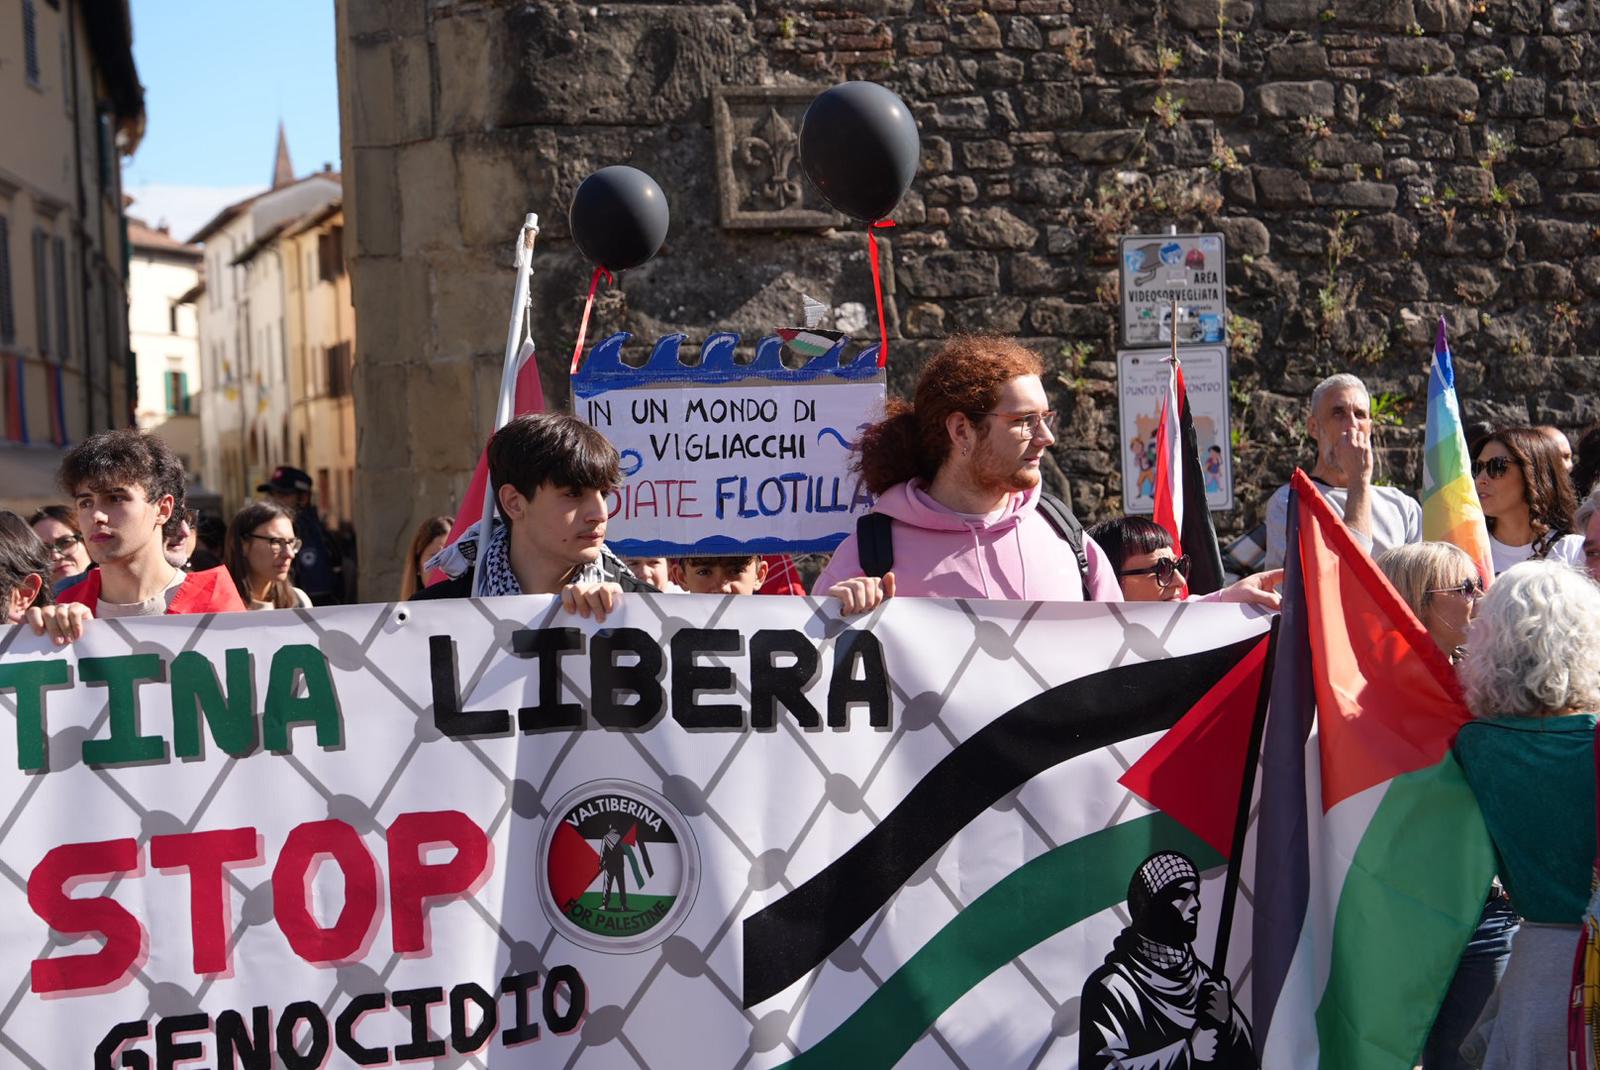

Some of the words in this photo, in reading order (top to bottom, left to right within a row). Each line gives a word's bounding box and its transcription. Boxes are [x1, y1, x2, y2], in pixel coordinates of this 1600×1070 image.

[1194, 271, 1218, 284] AREA
[1125, 385, 1157, 396] PUNTO
[588, 400, 612, 426] IN
[631, 399, 668, 424] UN
[685, 397, 777, 424] MONDO
[794, 399, 816, 423] DI
[650, 432, 806, 462] VIGLIACCHI
[715, 471, 876, 521] FLOTILLA
[0, 643, 344, 774] TINA
[429, 627, 892, 741] LIBERA
[566, 797, 663, 833] VALTIBERINA
[27, 810, 494, 998] STOP
[564, 896, 593, 925] FOR
[595, 900, 667, 931] PALESTINE
[94, 964, 588, 1070] GENOCIDIO
